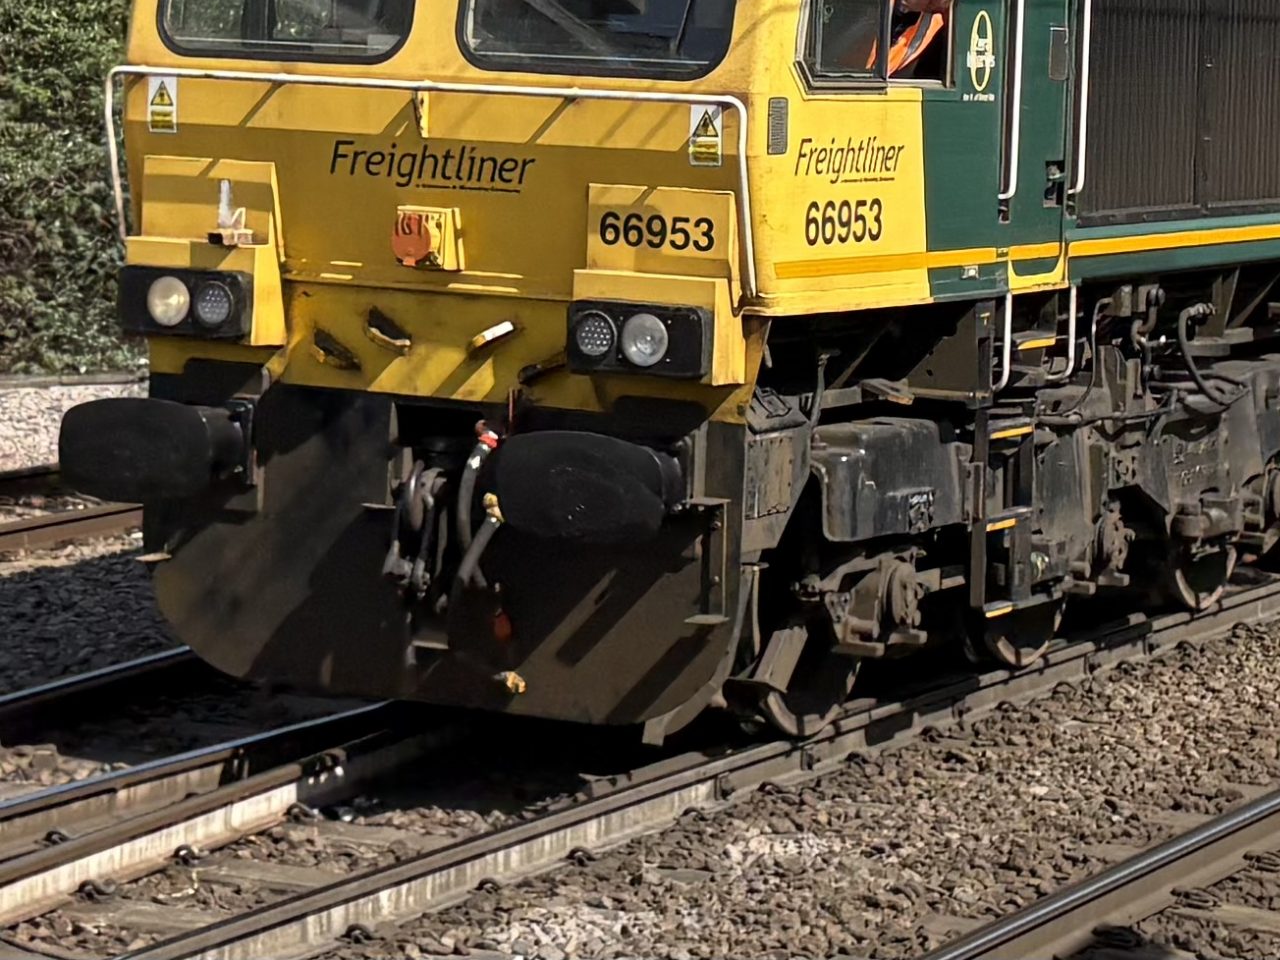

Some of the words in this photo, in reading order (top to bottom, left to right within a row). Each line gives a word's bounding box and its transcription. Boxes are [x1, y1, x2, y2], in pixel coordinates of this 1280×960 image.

[330, 140, 535, 187] Freightliner
[794, 136, 904, 184] Freightliner
[600, 211, 714, 252] 66953
[805, 198, 882, 246] 66953
